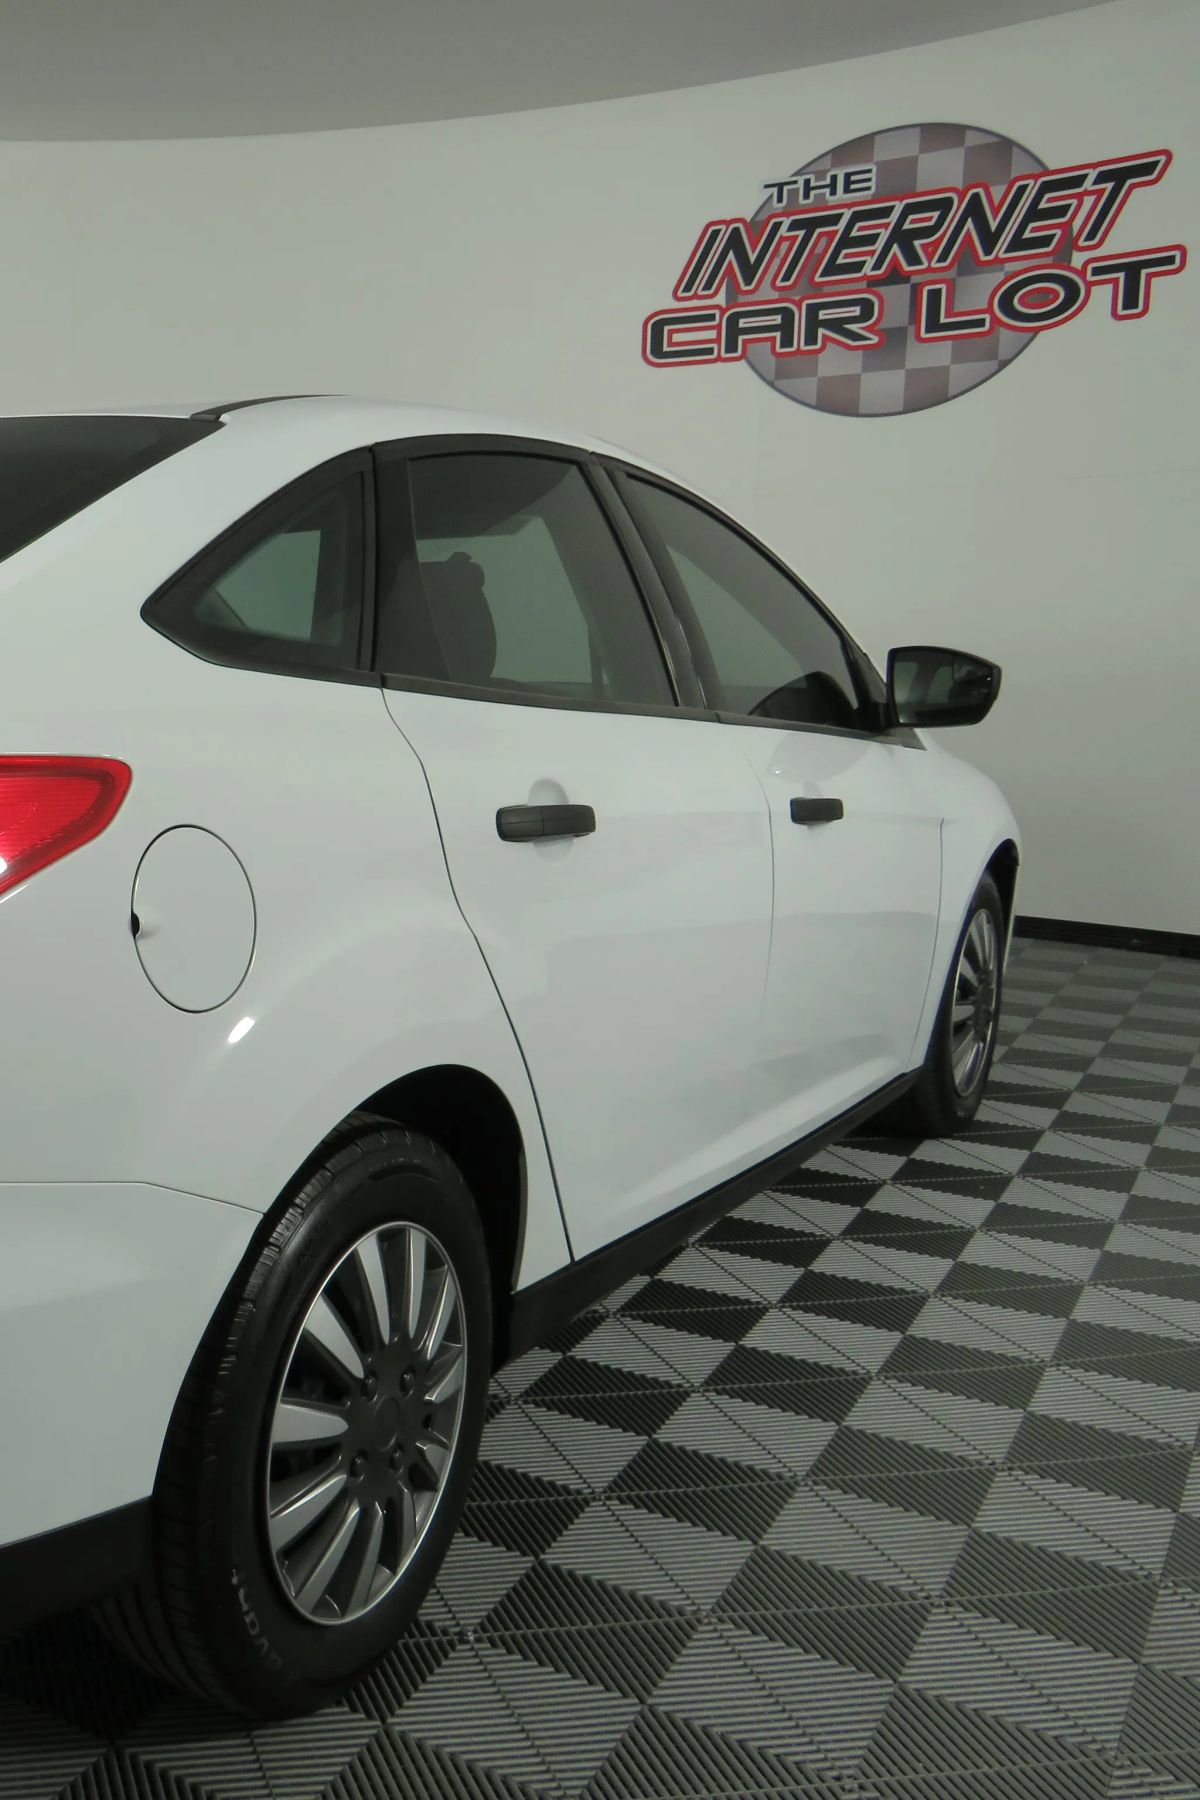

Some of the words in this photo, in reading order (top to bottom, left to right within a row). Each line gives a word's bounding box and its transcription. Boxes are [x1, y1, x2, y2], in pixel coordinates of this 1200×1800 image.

[674, 150, 1171, 299] INTERNET
[762, 166, 875, 206] THE
[643, 291, 883, 367] CAR
[917, 245, 1186, 341] LOT
